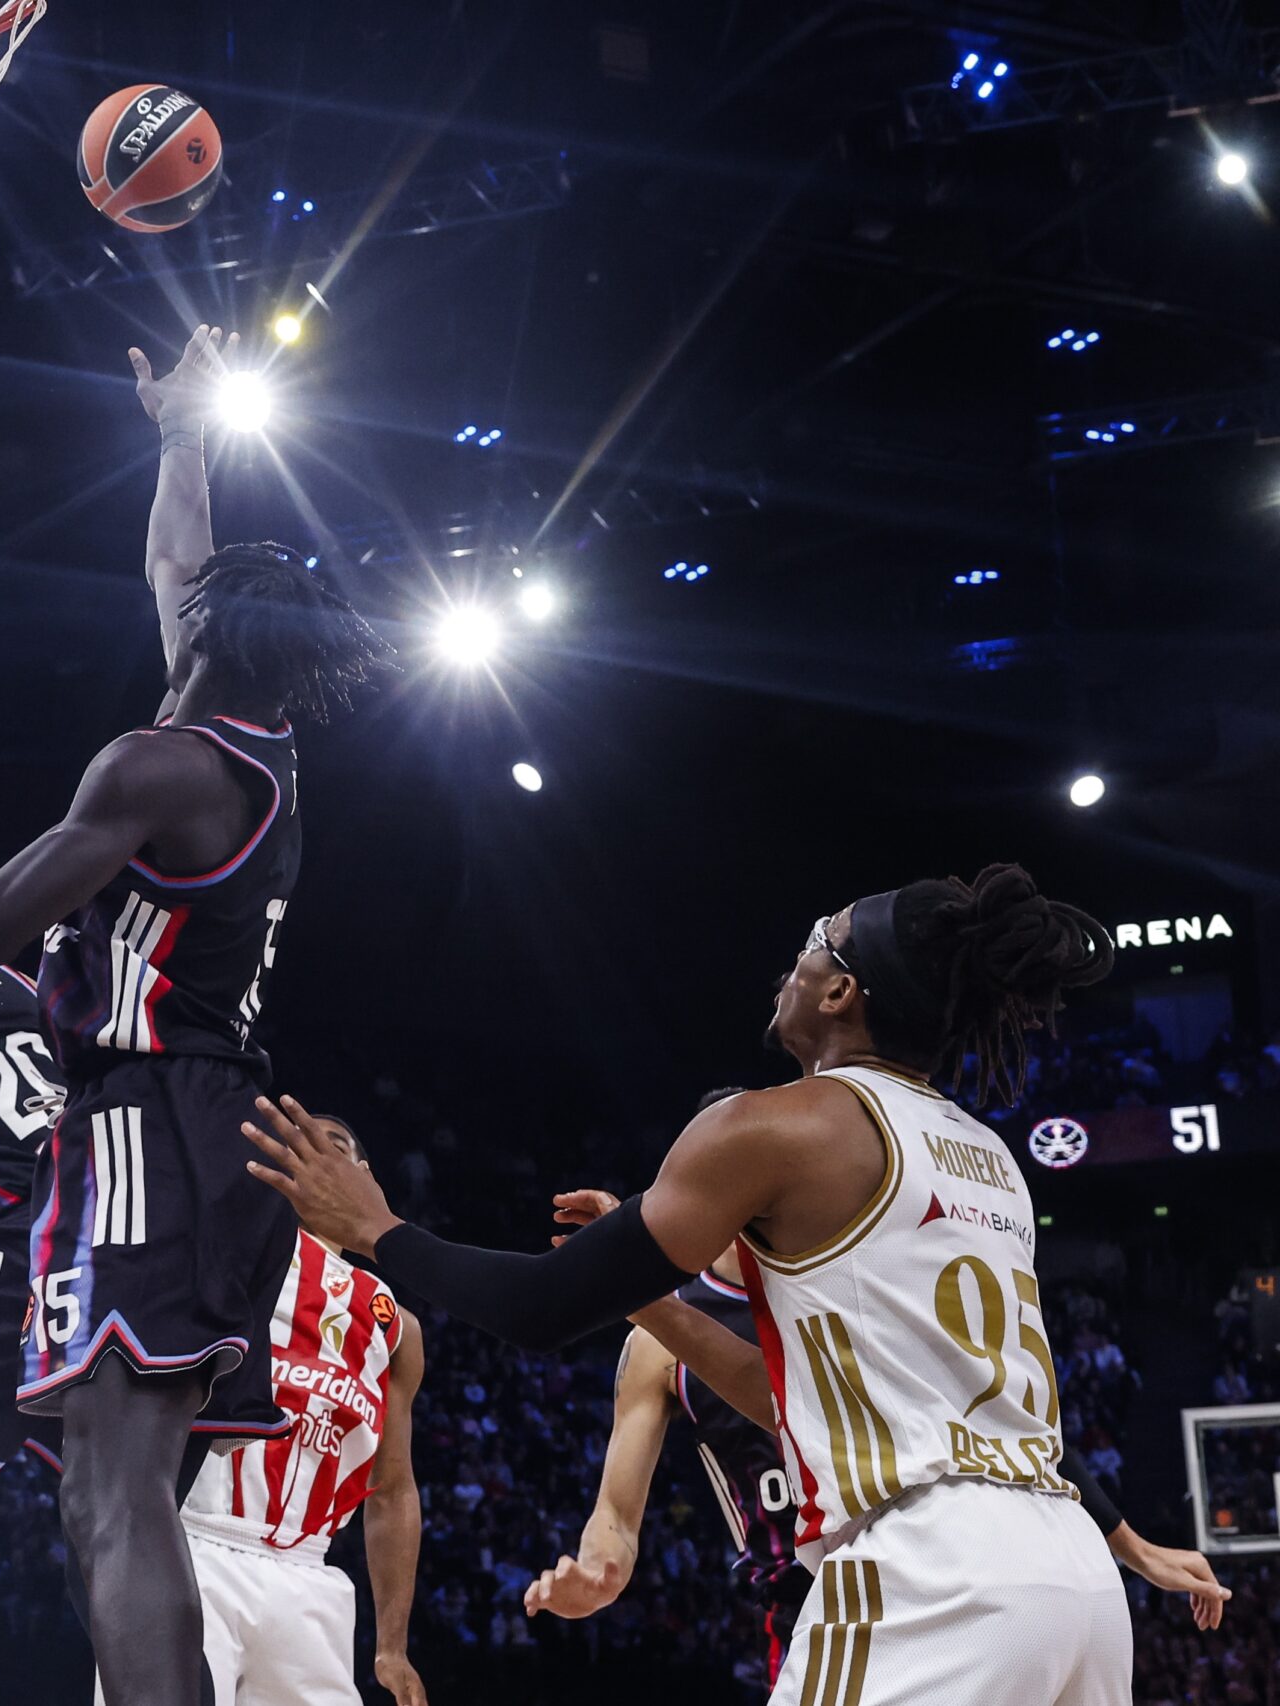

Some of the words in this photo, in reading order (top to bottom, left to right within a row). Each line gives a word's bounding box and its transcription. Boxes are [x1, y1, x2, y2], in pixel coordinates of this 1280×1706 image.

[120, 91, 196, 163] SPALDING
[1112, 914, 1233, 949] RENA
[922, 1130, 1017, 1195] MONEKE
[1170, 1104, 1221, 1154] 51
[934, 1254, 1059, 1430] 95
[271, 1357, 376, 1428] meridian
